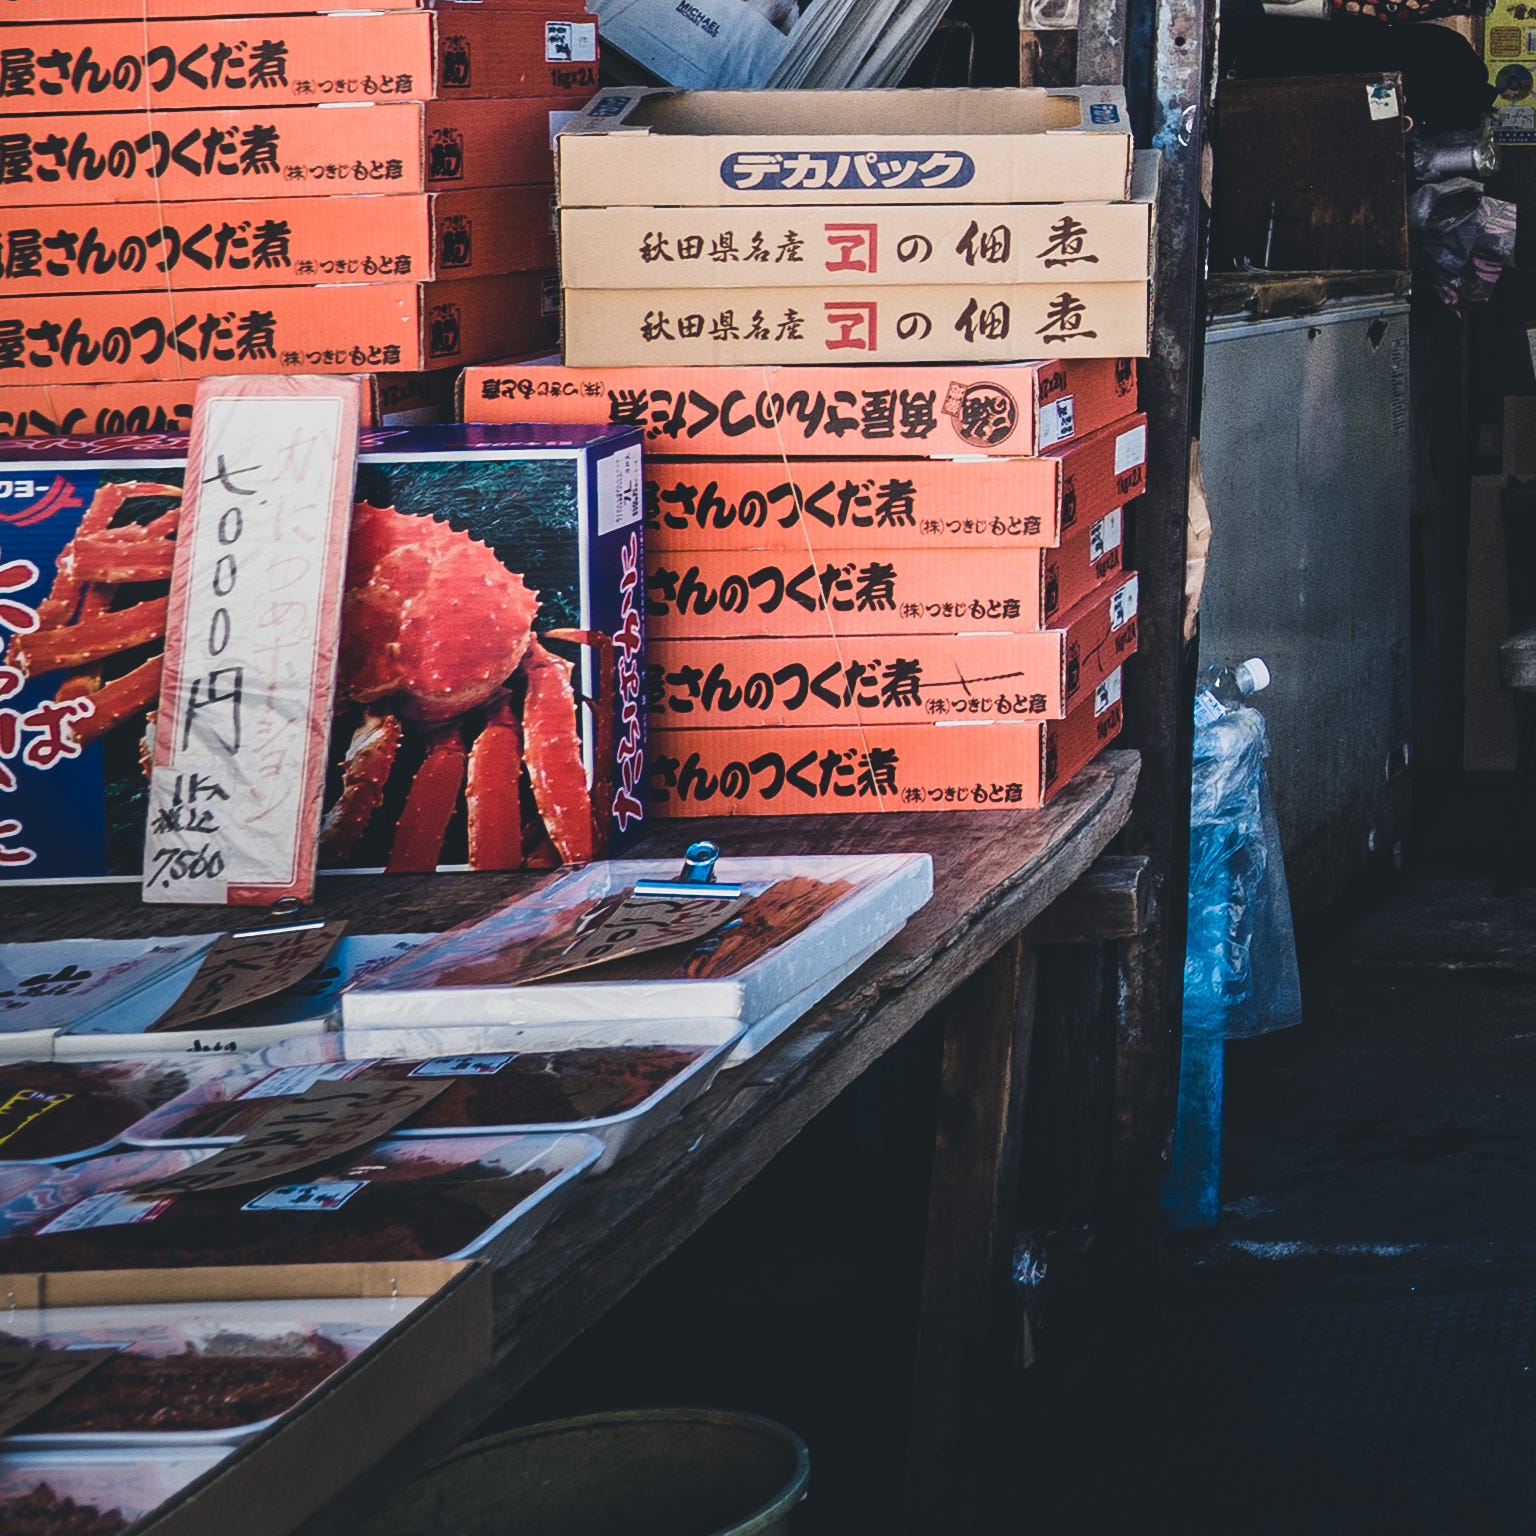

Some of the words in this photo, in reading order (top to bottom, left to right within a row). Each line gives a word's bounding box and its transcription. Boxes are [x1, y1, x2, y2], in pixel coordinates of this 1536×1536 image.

[675, 0, 721, 34] MICHAEL
[728, 153, 966, 187] デカパック
[638, 231, 804, 265] 秋田県名産
[638, 308, 804, 342] 秋田県名産
